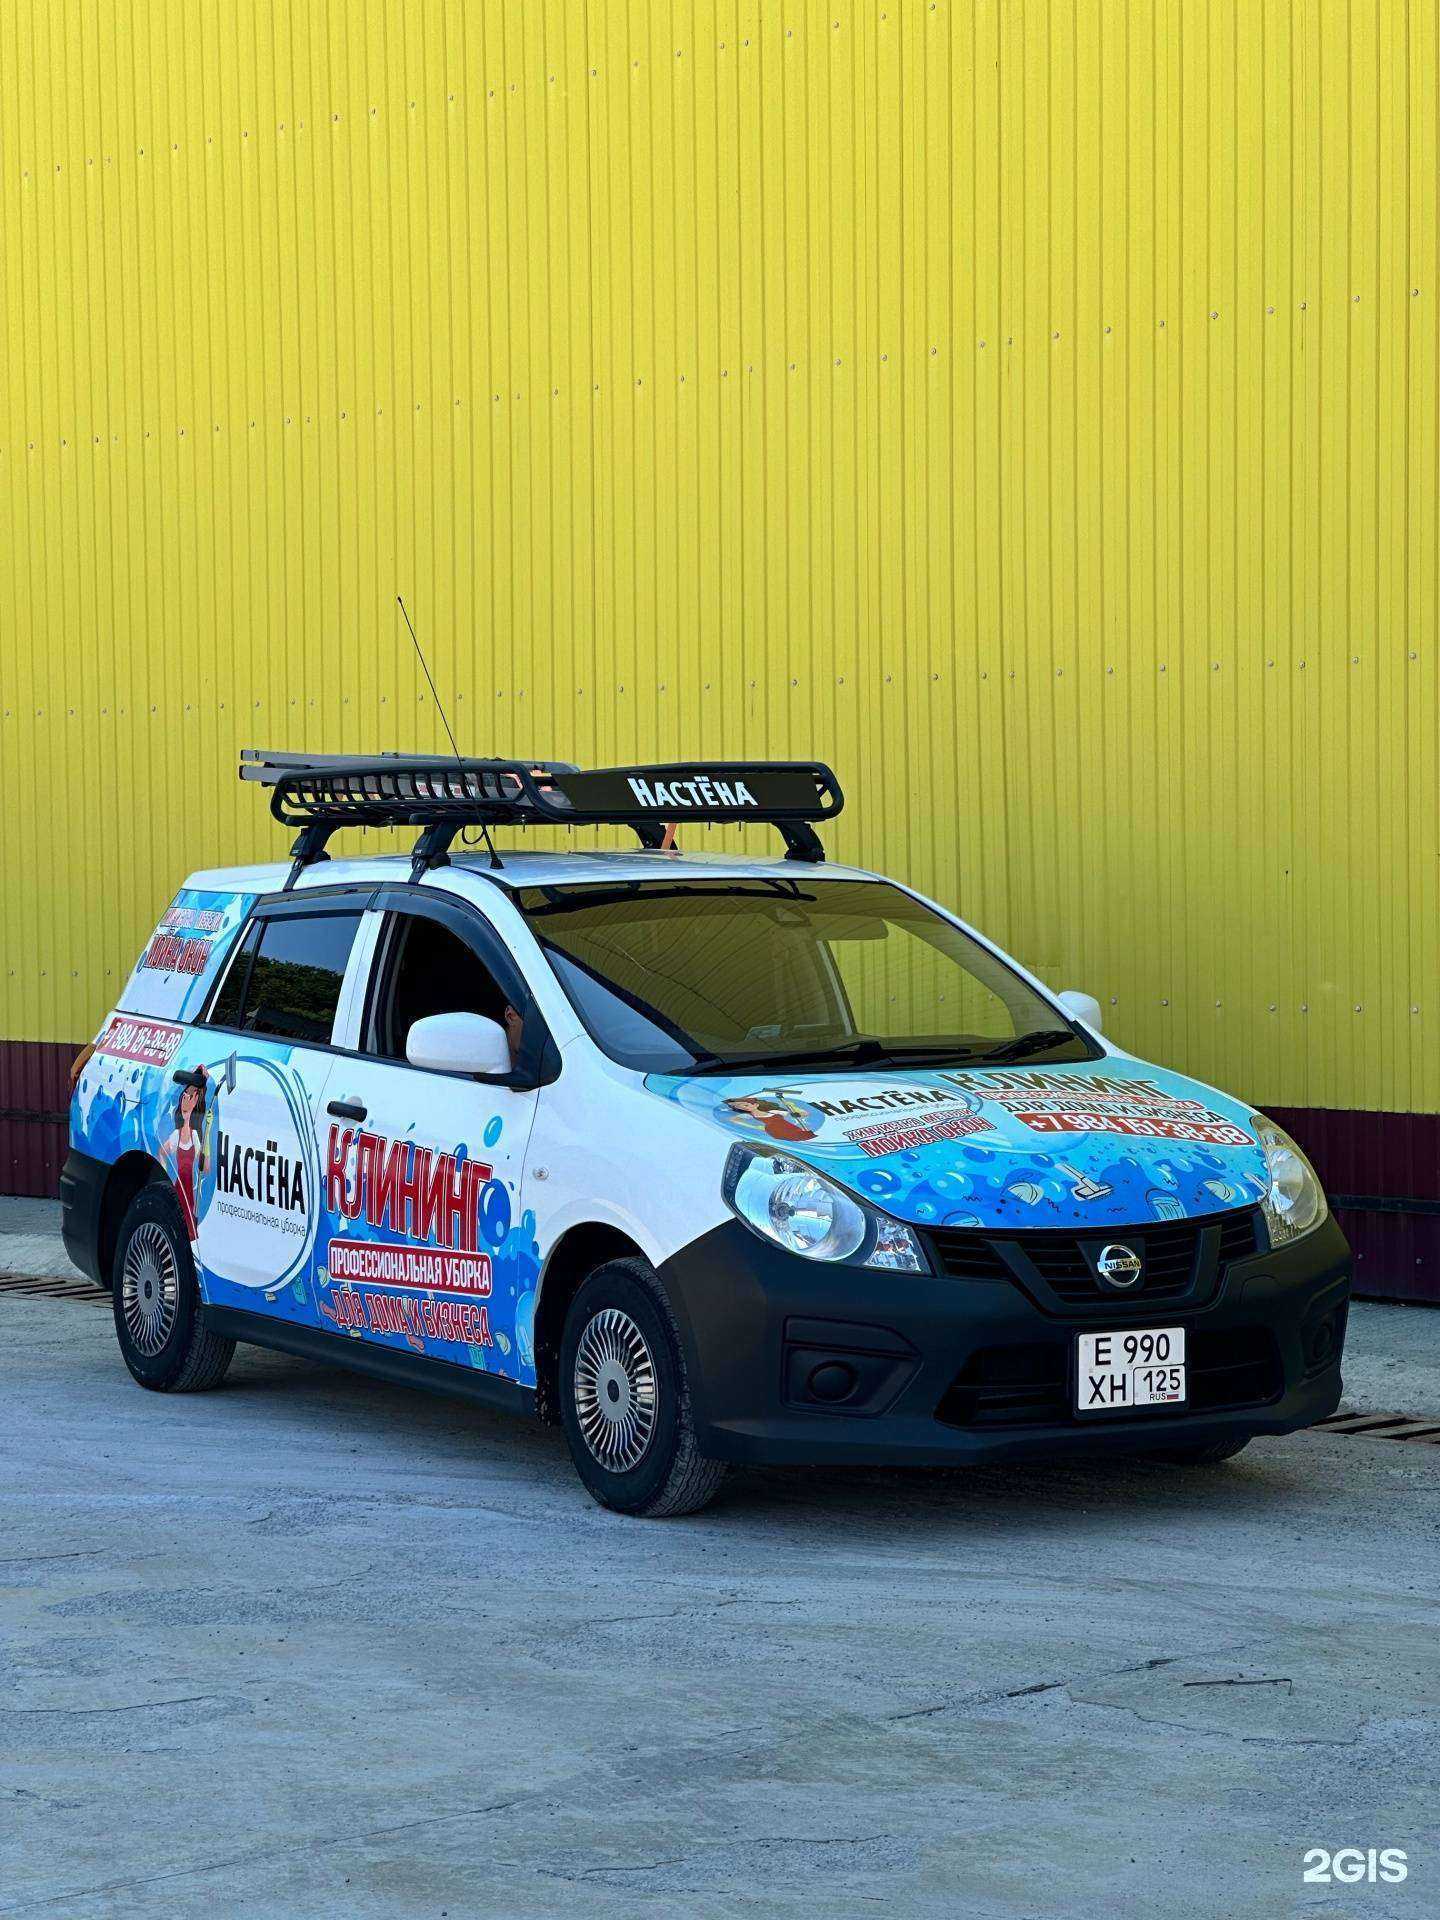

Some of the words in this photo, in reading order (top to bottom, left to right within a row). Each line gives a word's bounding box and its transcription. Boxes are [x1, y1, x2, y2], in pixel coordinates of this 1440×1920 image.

[627, 776, 759, 807] НАСТЁНА
[940, 1072, 1176, 1100] КЛИНИНГ
[810, 1090, 954, 1117] НАСТЁНА
[857, 1128, 938, 1158] МОЙКА
[932, 1116, 996, 1142] ОКОН
[1028, 1115, 1064, 1130] +7
[1061, 1115, 1124, 1133] 984
[1117, 1117, 1249, 1144] 151-38-88
[217, 1131, 306, 1215] НАСТЁНА
[326, 1123, 493, 1252] КЛИНИНГ
[330, 1246, 442, 1286] ПРОФЕССИОНАЛЬНАЯ
[445, 1258, 490, 1291] УБОРКА
[1104, 1259, 1141, 1270] NISSAN
[331, 1290, 367, 1330] ДЛЯ
[365, 1293, 408, 1334] ДОМА
[421, 1299, 493, 1346] БИЗНЕСА
[1124, 1333, 1170, 1364] 990
[1143, 1368, 1181, 1393] 125
[1150, 1392, 1167, 1401] RUS
